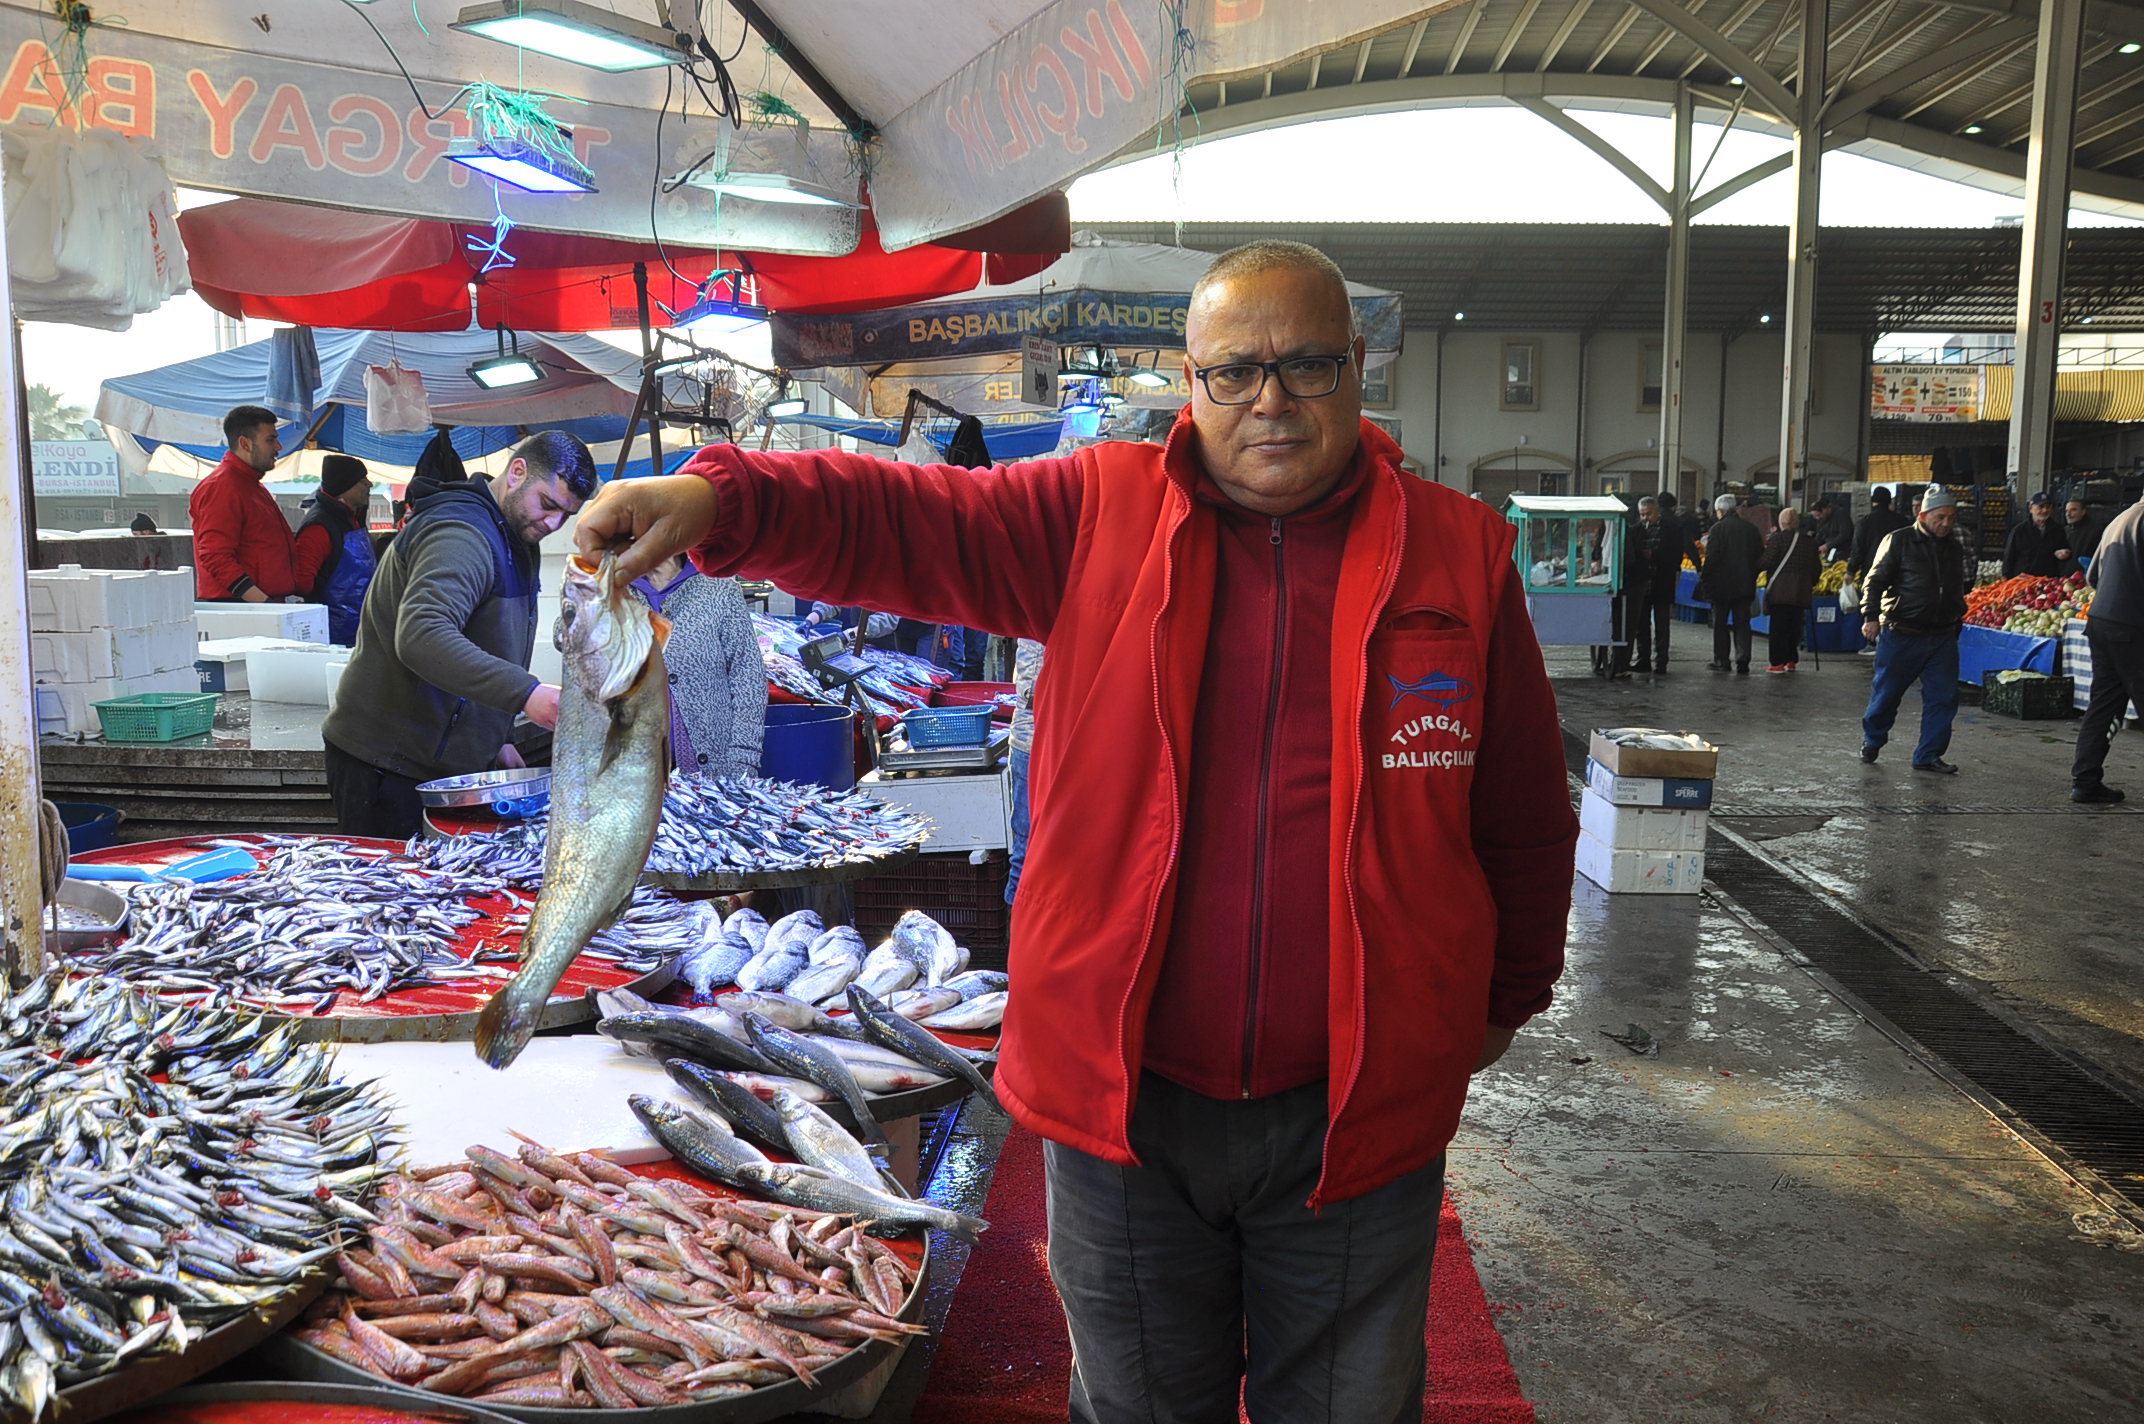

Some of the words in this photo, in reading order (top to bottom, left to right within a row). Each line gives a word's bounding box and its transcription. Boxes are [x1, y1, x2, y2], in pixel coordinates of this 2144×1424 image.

[2041, 301, 2054, 323] 3
[909, 303, 1069, 345] BAŞBALIKÇI
[1883, 367, 1902, 375] ALTIN
[1958, 386, 1972, 398] 150
[1928, 413, 1943, 422] 70
[1391, 715, 1472, 745] TURGAY
[1381, 750, 1476, 770] BALIKÇILIK
[1675, 788, 1699, 798] SPERRE
